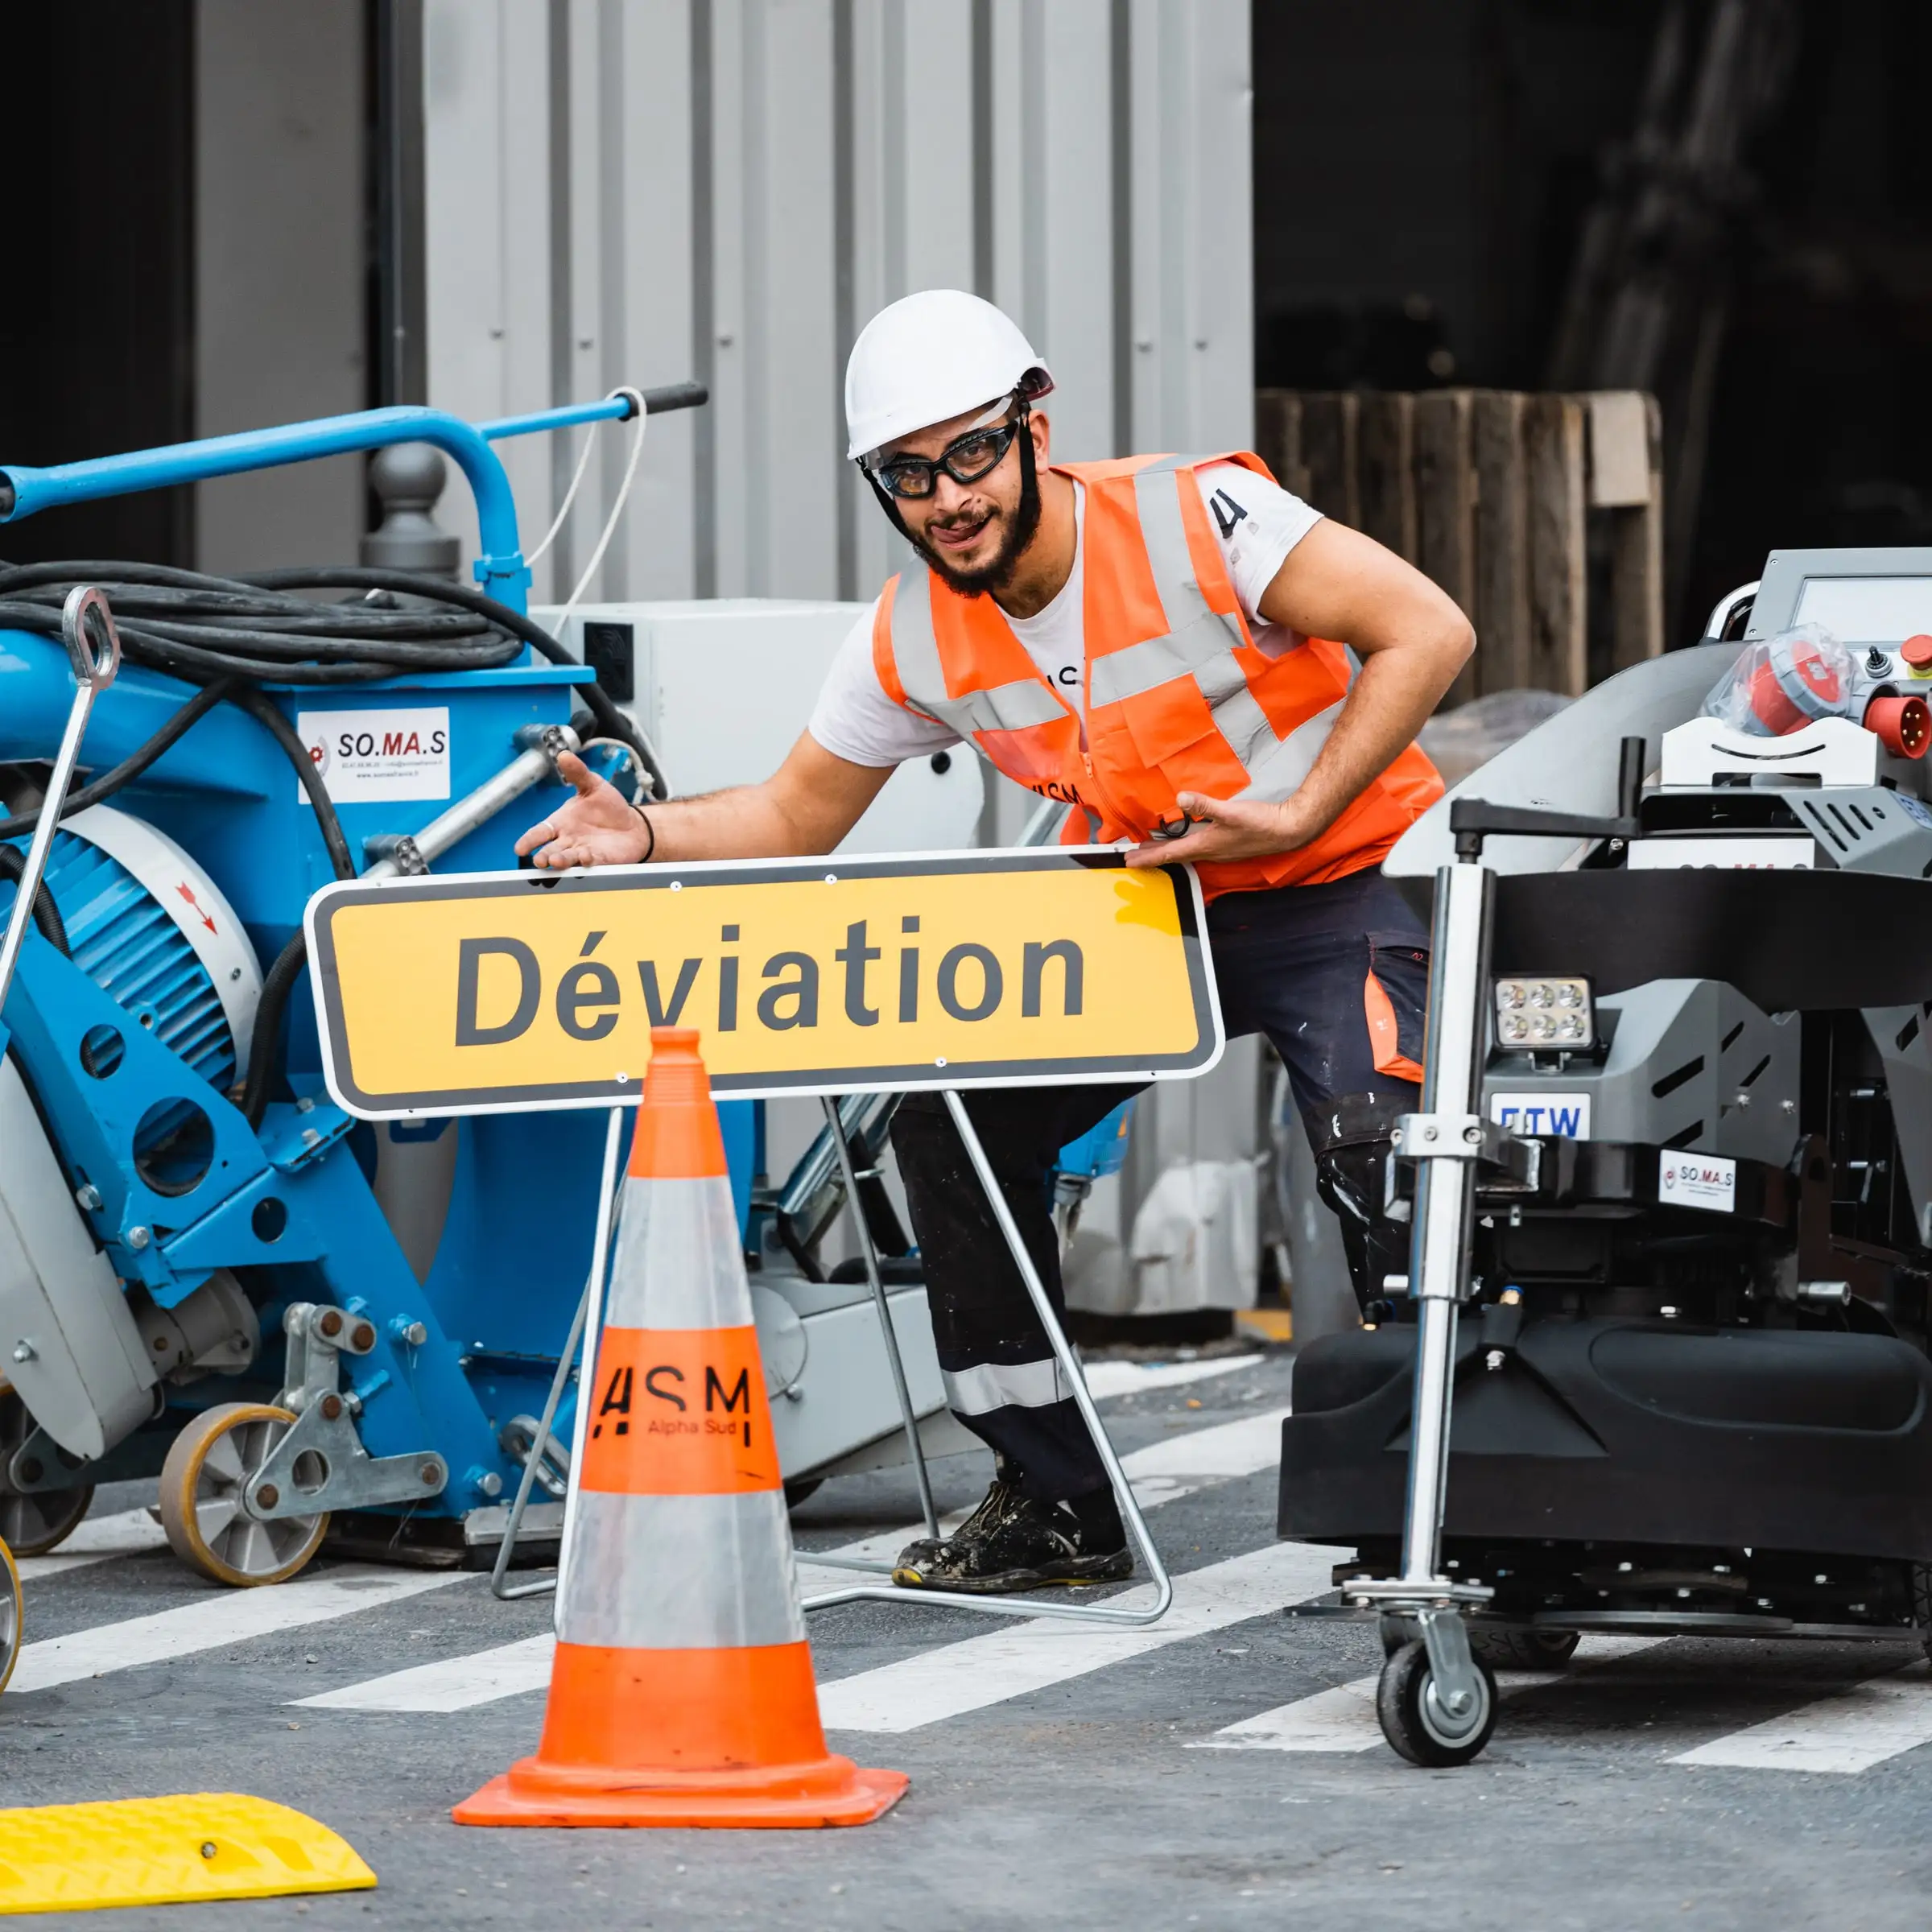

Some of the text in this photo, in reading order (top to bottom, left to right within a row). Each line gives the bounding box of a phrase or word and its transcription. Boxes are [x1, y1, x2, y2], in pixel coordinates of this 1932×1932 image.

[338, 731, 446, 757] SO.MA.S
[456, 915, 1084, 1046] Déviation
[1680, 1166, 1733, 1187] SO.MA.S
[592, 1365, 750, 1447] ASM
[648, 1420, 736, 1435] Alpha Sud
